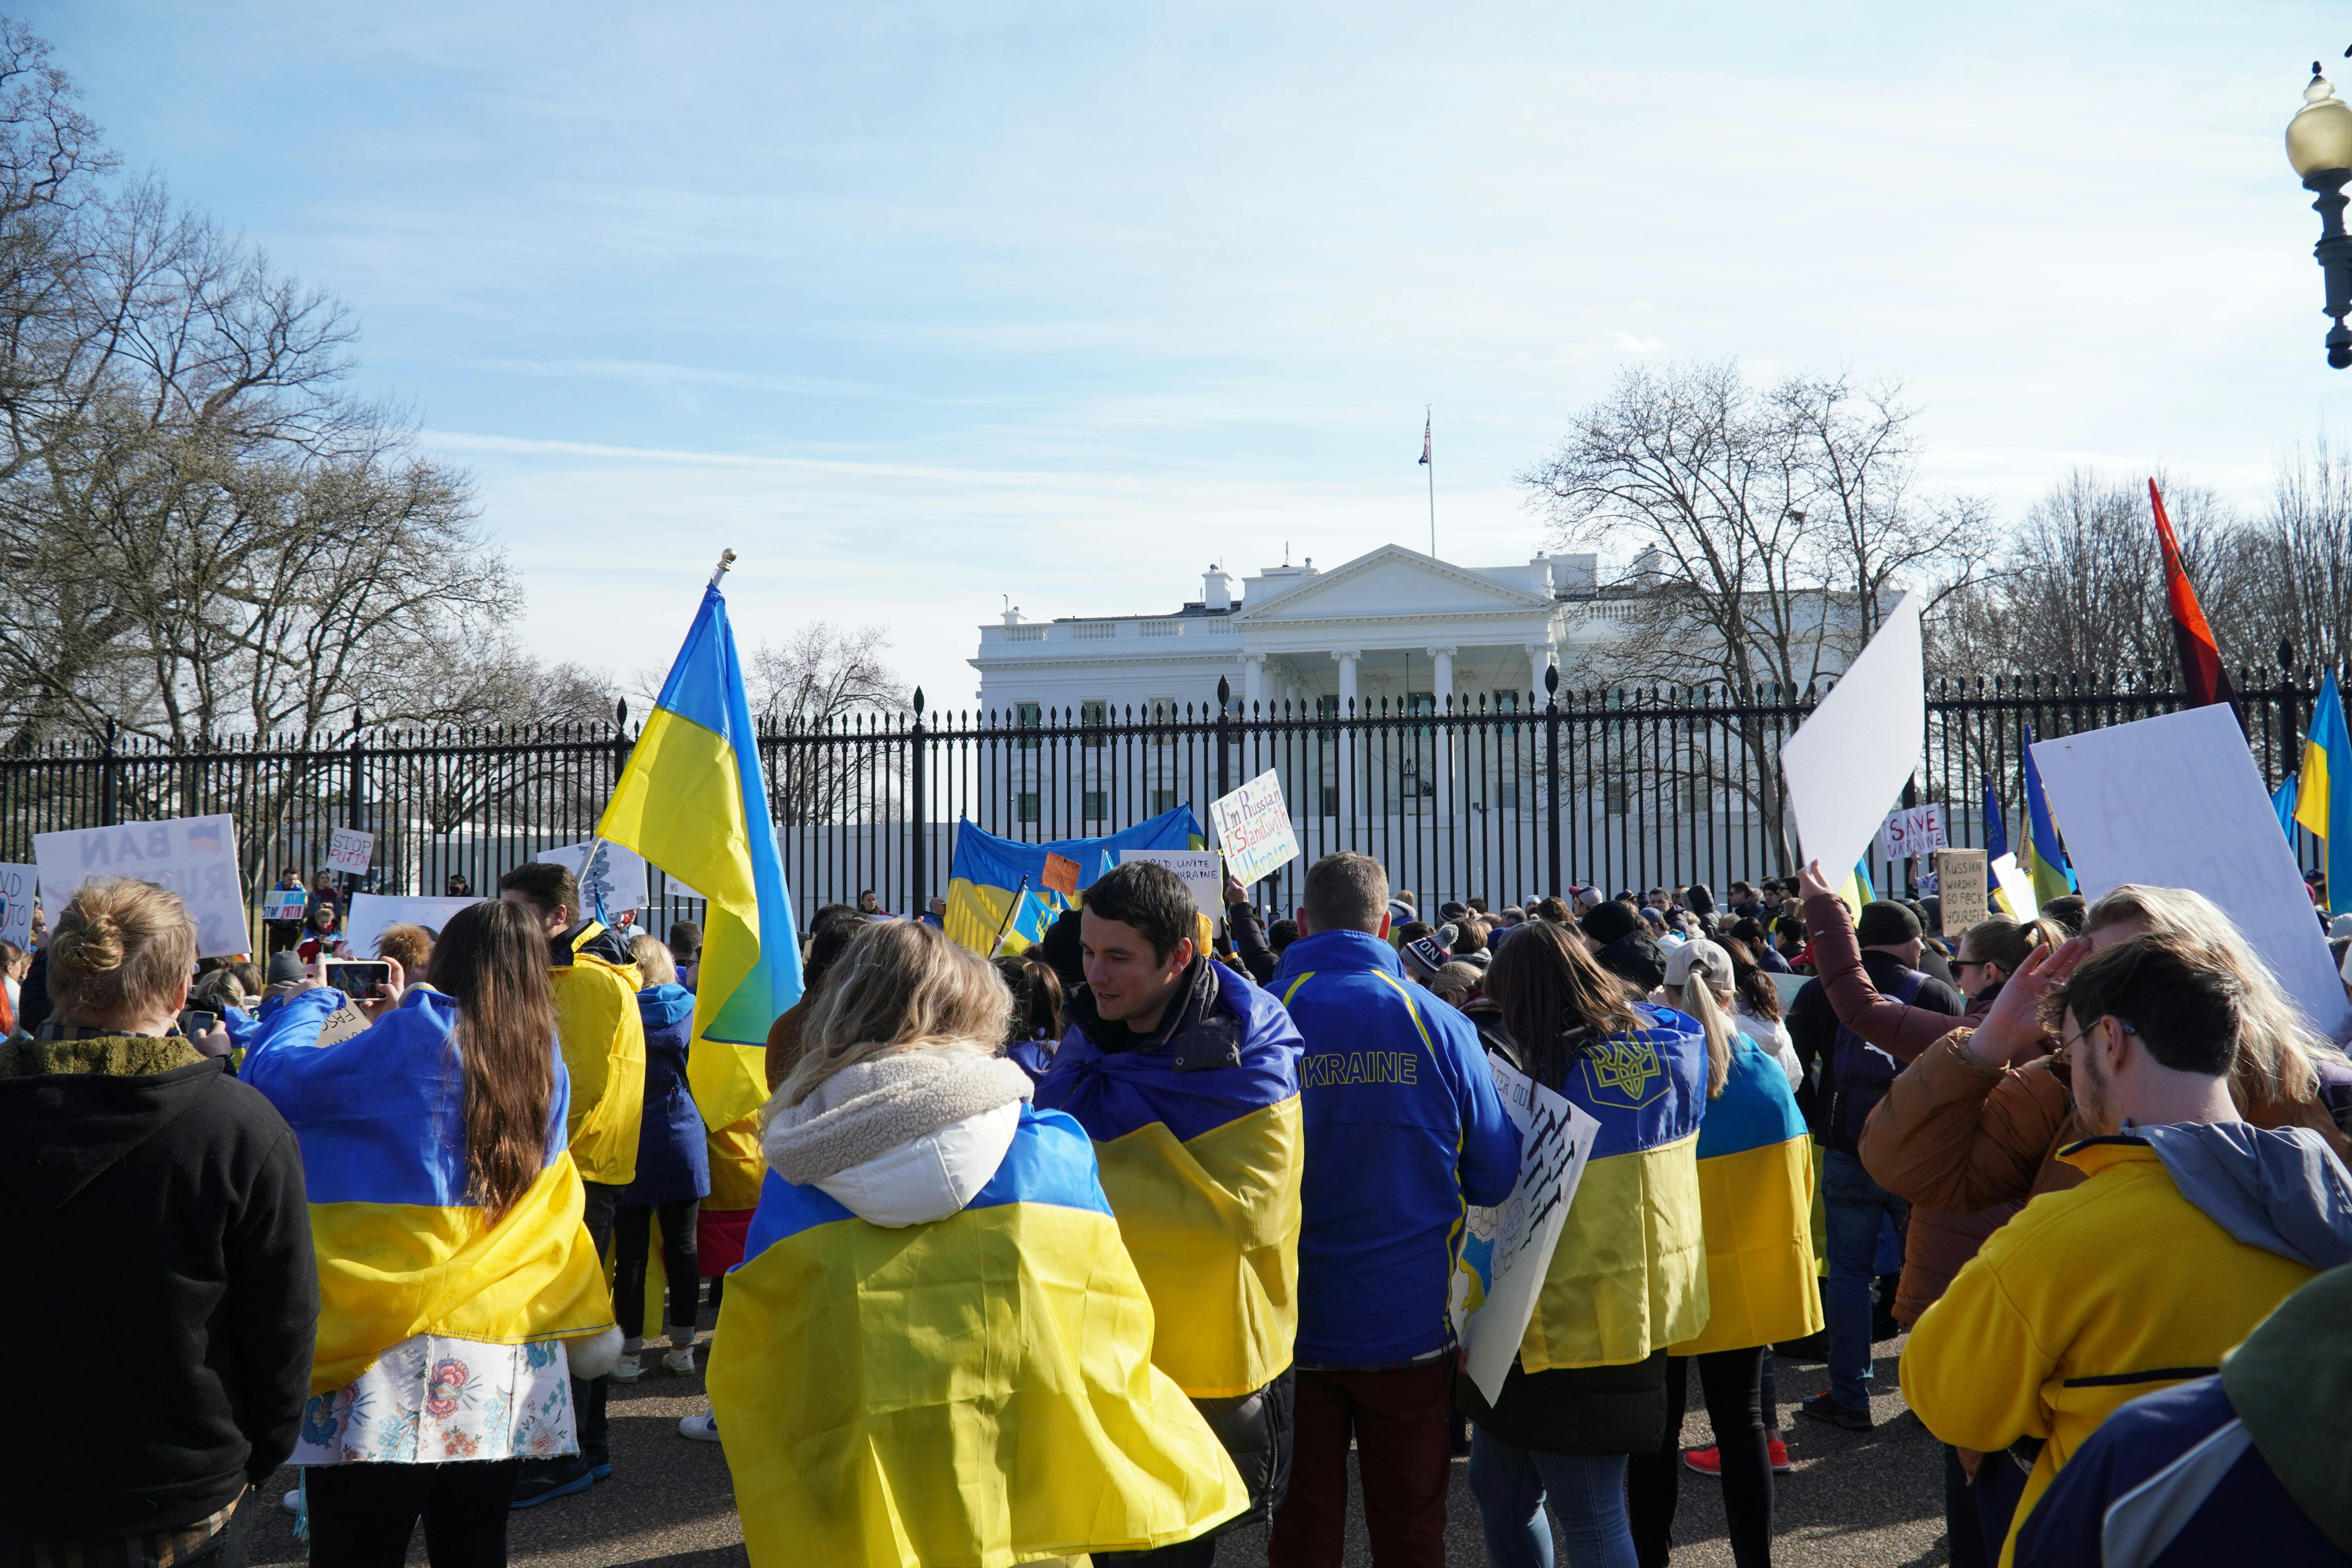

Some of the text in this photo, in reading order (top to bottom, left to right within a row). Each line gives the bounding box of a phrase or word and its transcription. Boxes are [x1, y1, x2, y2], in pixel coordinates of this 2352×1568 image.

[1218, 790, 1281, 833] I'm Russian
[1890, 809, 1940, 841] SAVE
[334, 834, 371, 853] STOP
[1225, 834, 1235, 858] I
[330, 848, 369, 868] PUTIN
[1048, 855, 1078, 875] NO-FLY
[1044, 869, 1069, 889] ZONE
[1946, 893, 1957, 905] GO
[262, 906, 301, 918] STOP PUTIN
[1946, 909, 1986, 924] YOURSELF
